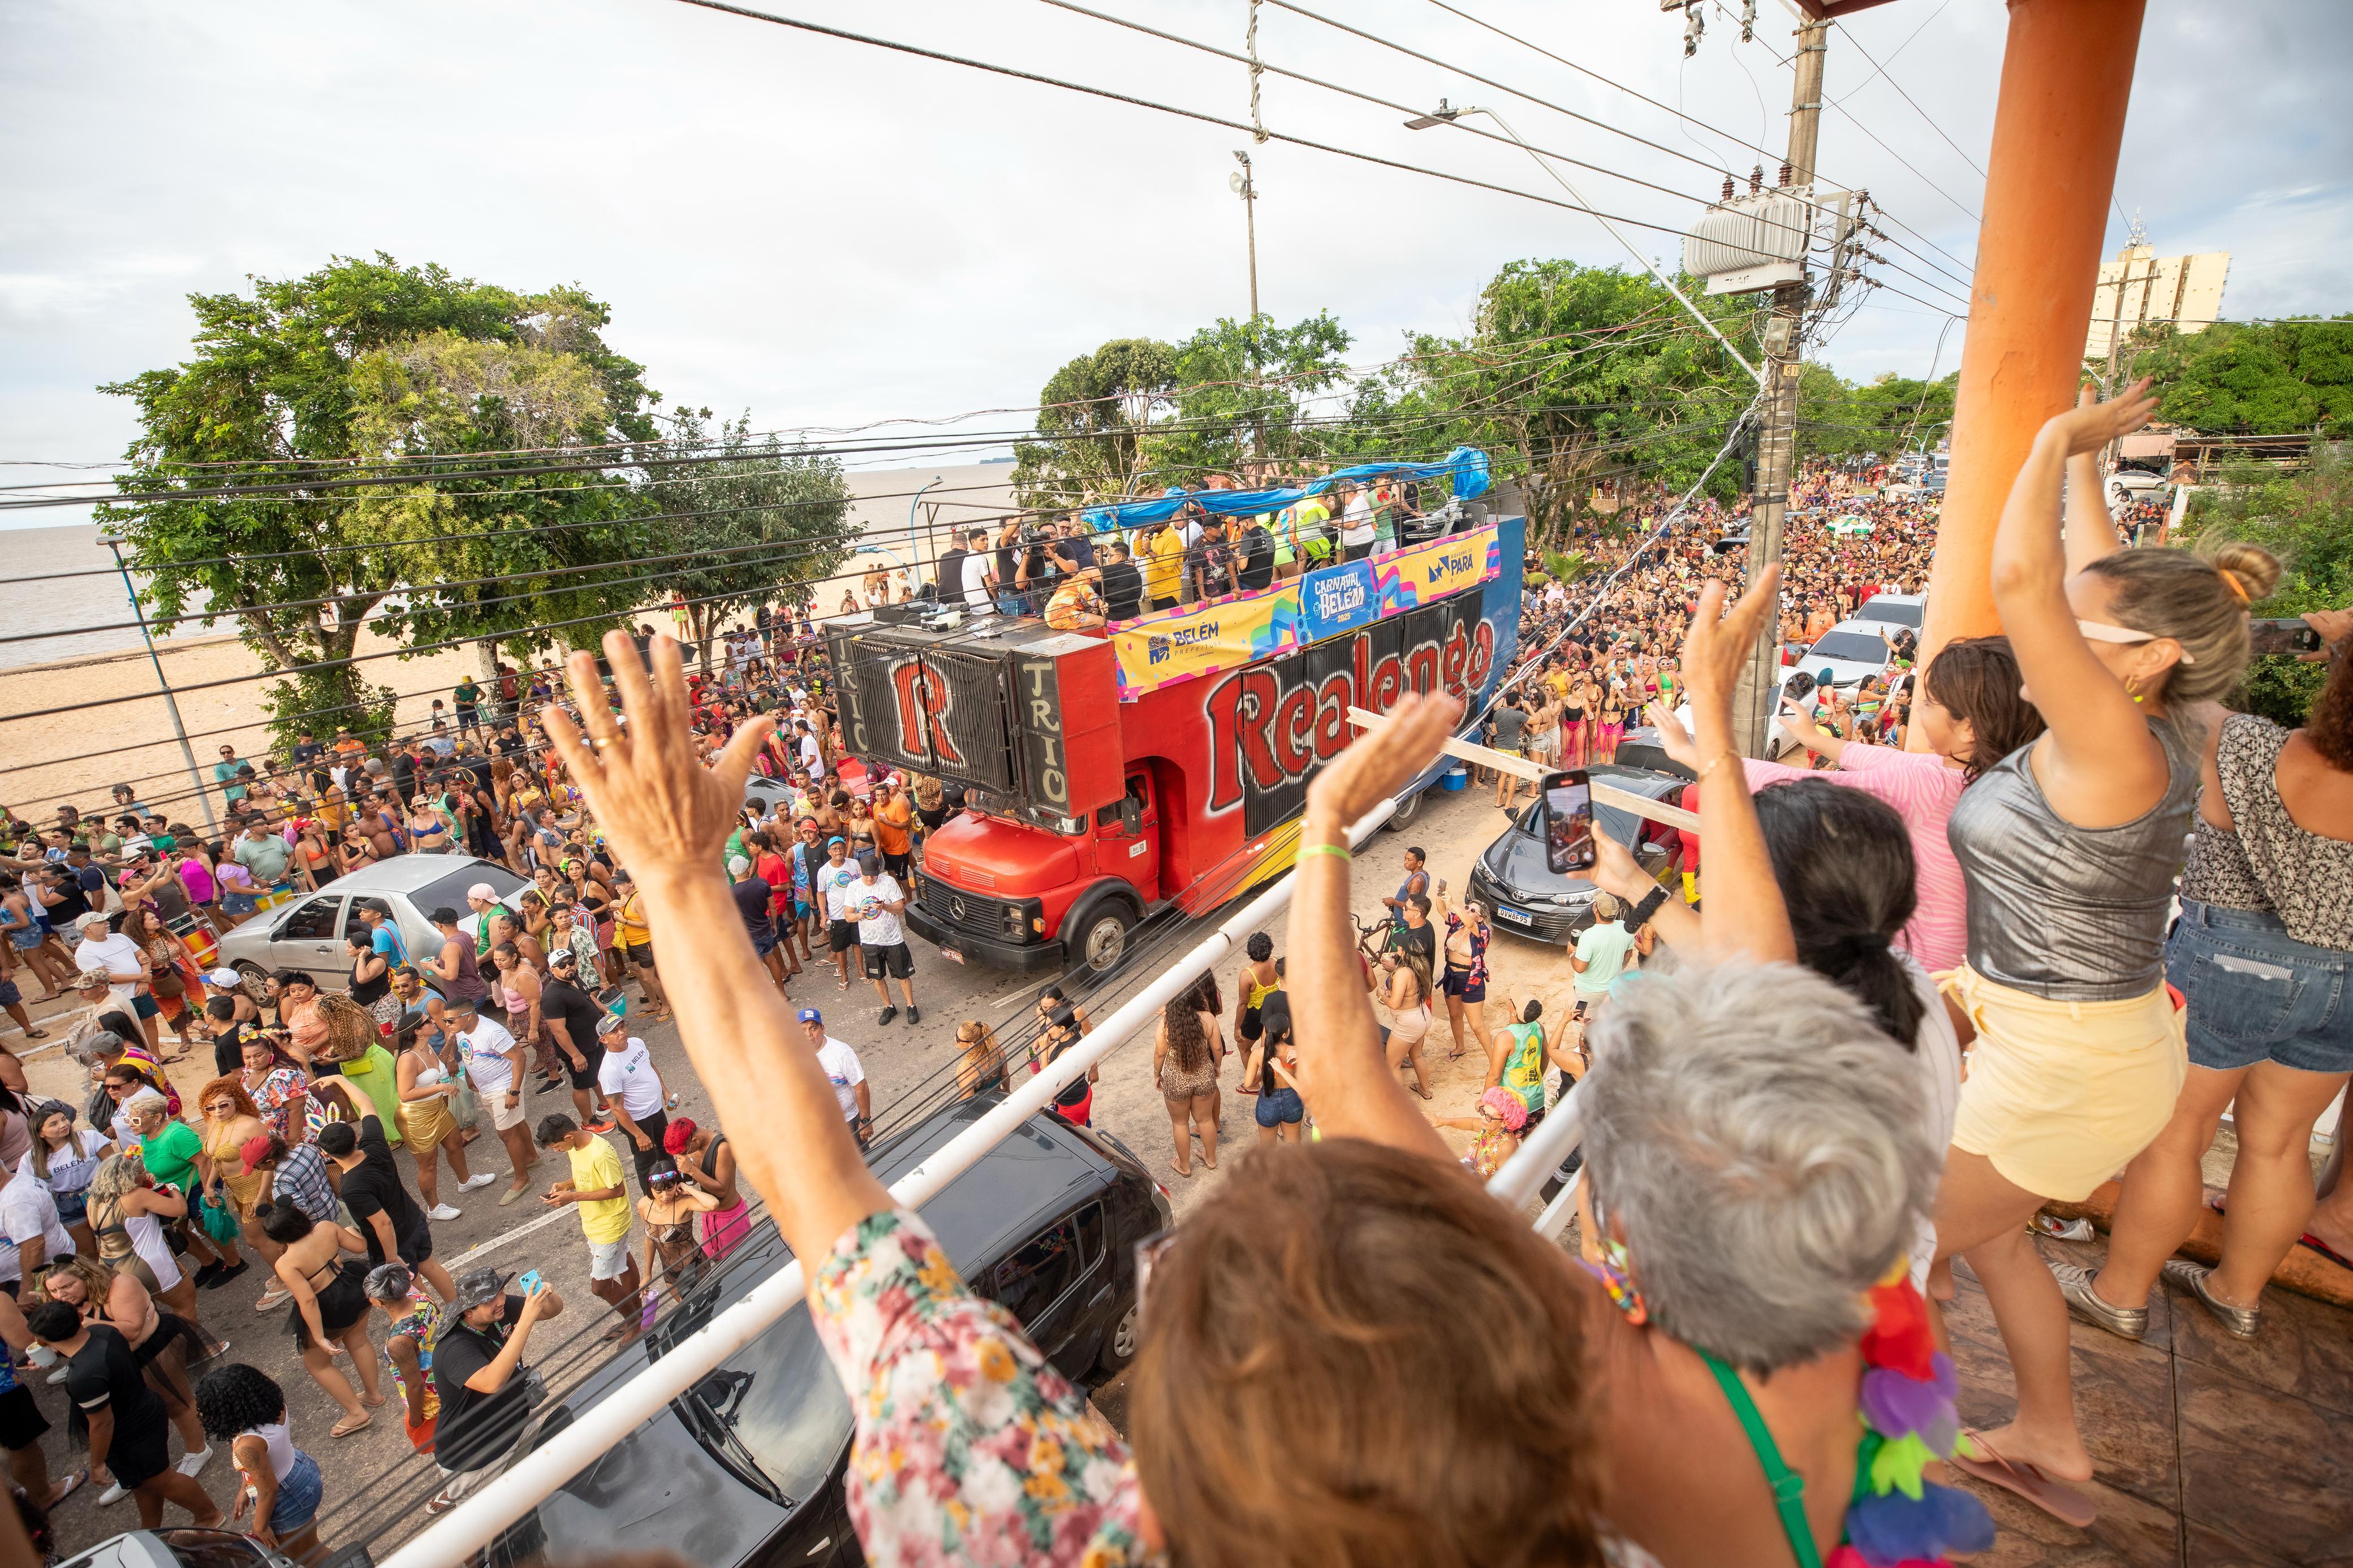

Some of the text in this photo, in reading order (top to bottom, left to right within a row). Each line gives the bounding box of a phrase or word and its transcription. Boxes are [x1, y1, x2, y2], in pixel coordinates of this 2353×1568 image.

[1451, 550, 1467, 559] GOVERNO
[1315, 572, 1361, 595] CARNAVAL
[1320, 586, 1365, 620] BELÉM
[1337, 612, 1351, 623] 2025
[1173, 621, 1219, 647] BELÉM
[1174, 641, 1222, 656] PREFEITURA
[889, 654, 965, 768] R
[1205, 618, 1495, 818] Realengo
[1023, 660, 1067, 803] TRIO
[1500, 909, 1528, 923] QVW8F95
